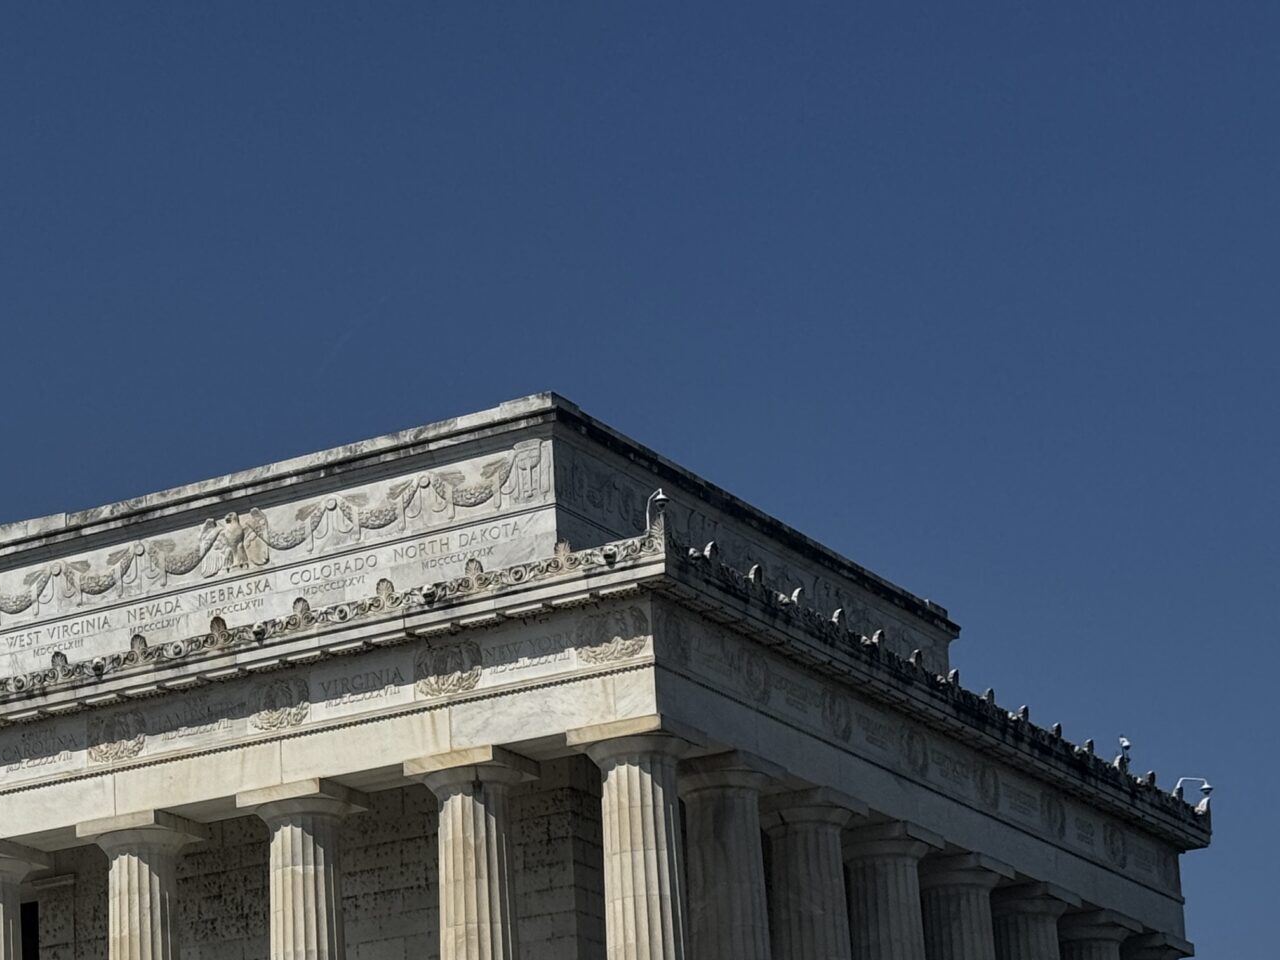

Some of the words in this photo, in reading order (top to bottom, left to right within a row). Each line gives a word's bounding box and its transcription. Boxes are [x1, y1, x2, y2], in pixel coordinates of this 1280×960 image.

[393, 537, 450, 563] NORTH
[458, 521, 521, 546] DAKOTA
[290, 554, 378, 586] COLORADO
[198, 578, 272, 607] NEBRASKA
[127, 598, 183, 623] NEVADA
[5, 630, 42, 649] WEST
[46, 615, 112, 642] VIRGINIA
[482, 641, 523, 665] NEW
[528, 632, 576, 654] YORK
[319, 666, 405, 699] VIRGINIA
